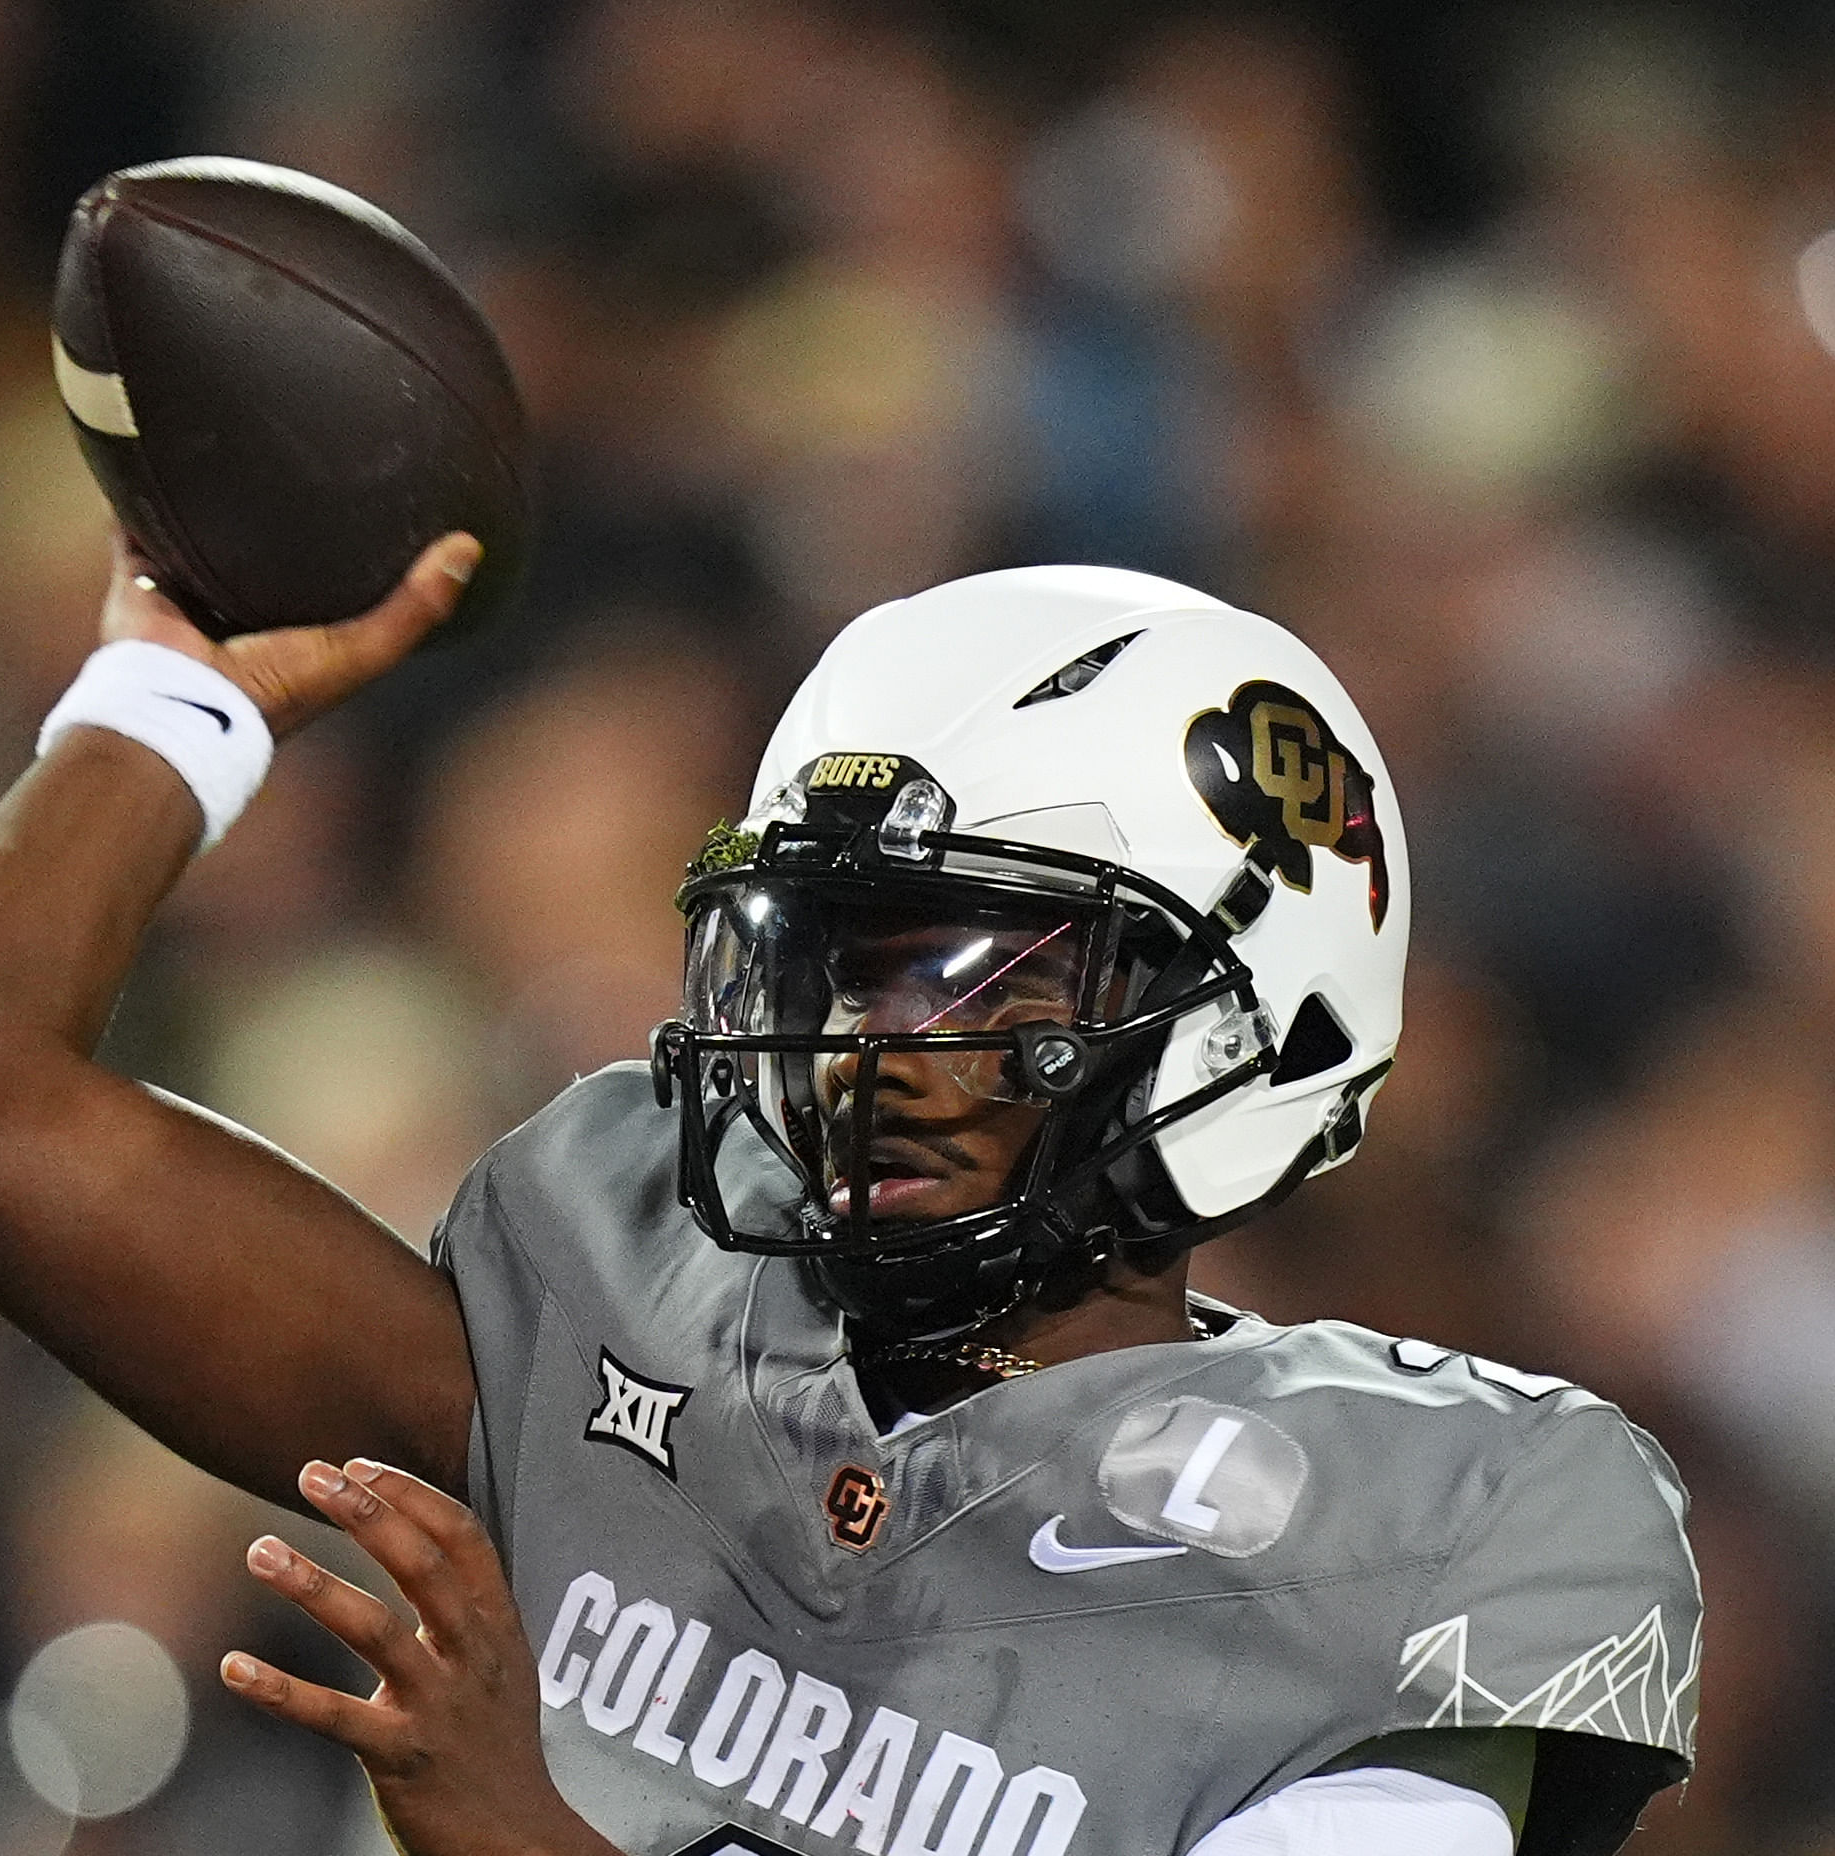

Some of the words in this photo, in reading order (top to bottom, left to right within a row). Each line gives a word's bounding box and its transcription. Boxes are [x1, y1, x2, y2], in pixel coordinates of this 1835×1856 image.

[808, 755, 900, 788] BUFFS
[1250, 701, 1347, 847] CU
[589, 1357, 684, 1468] XII
[827, 1467, 886, 1546] CU
[1161, 1417, 1245, 1532] L
